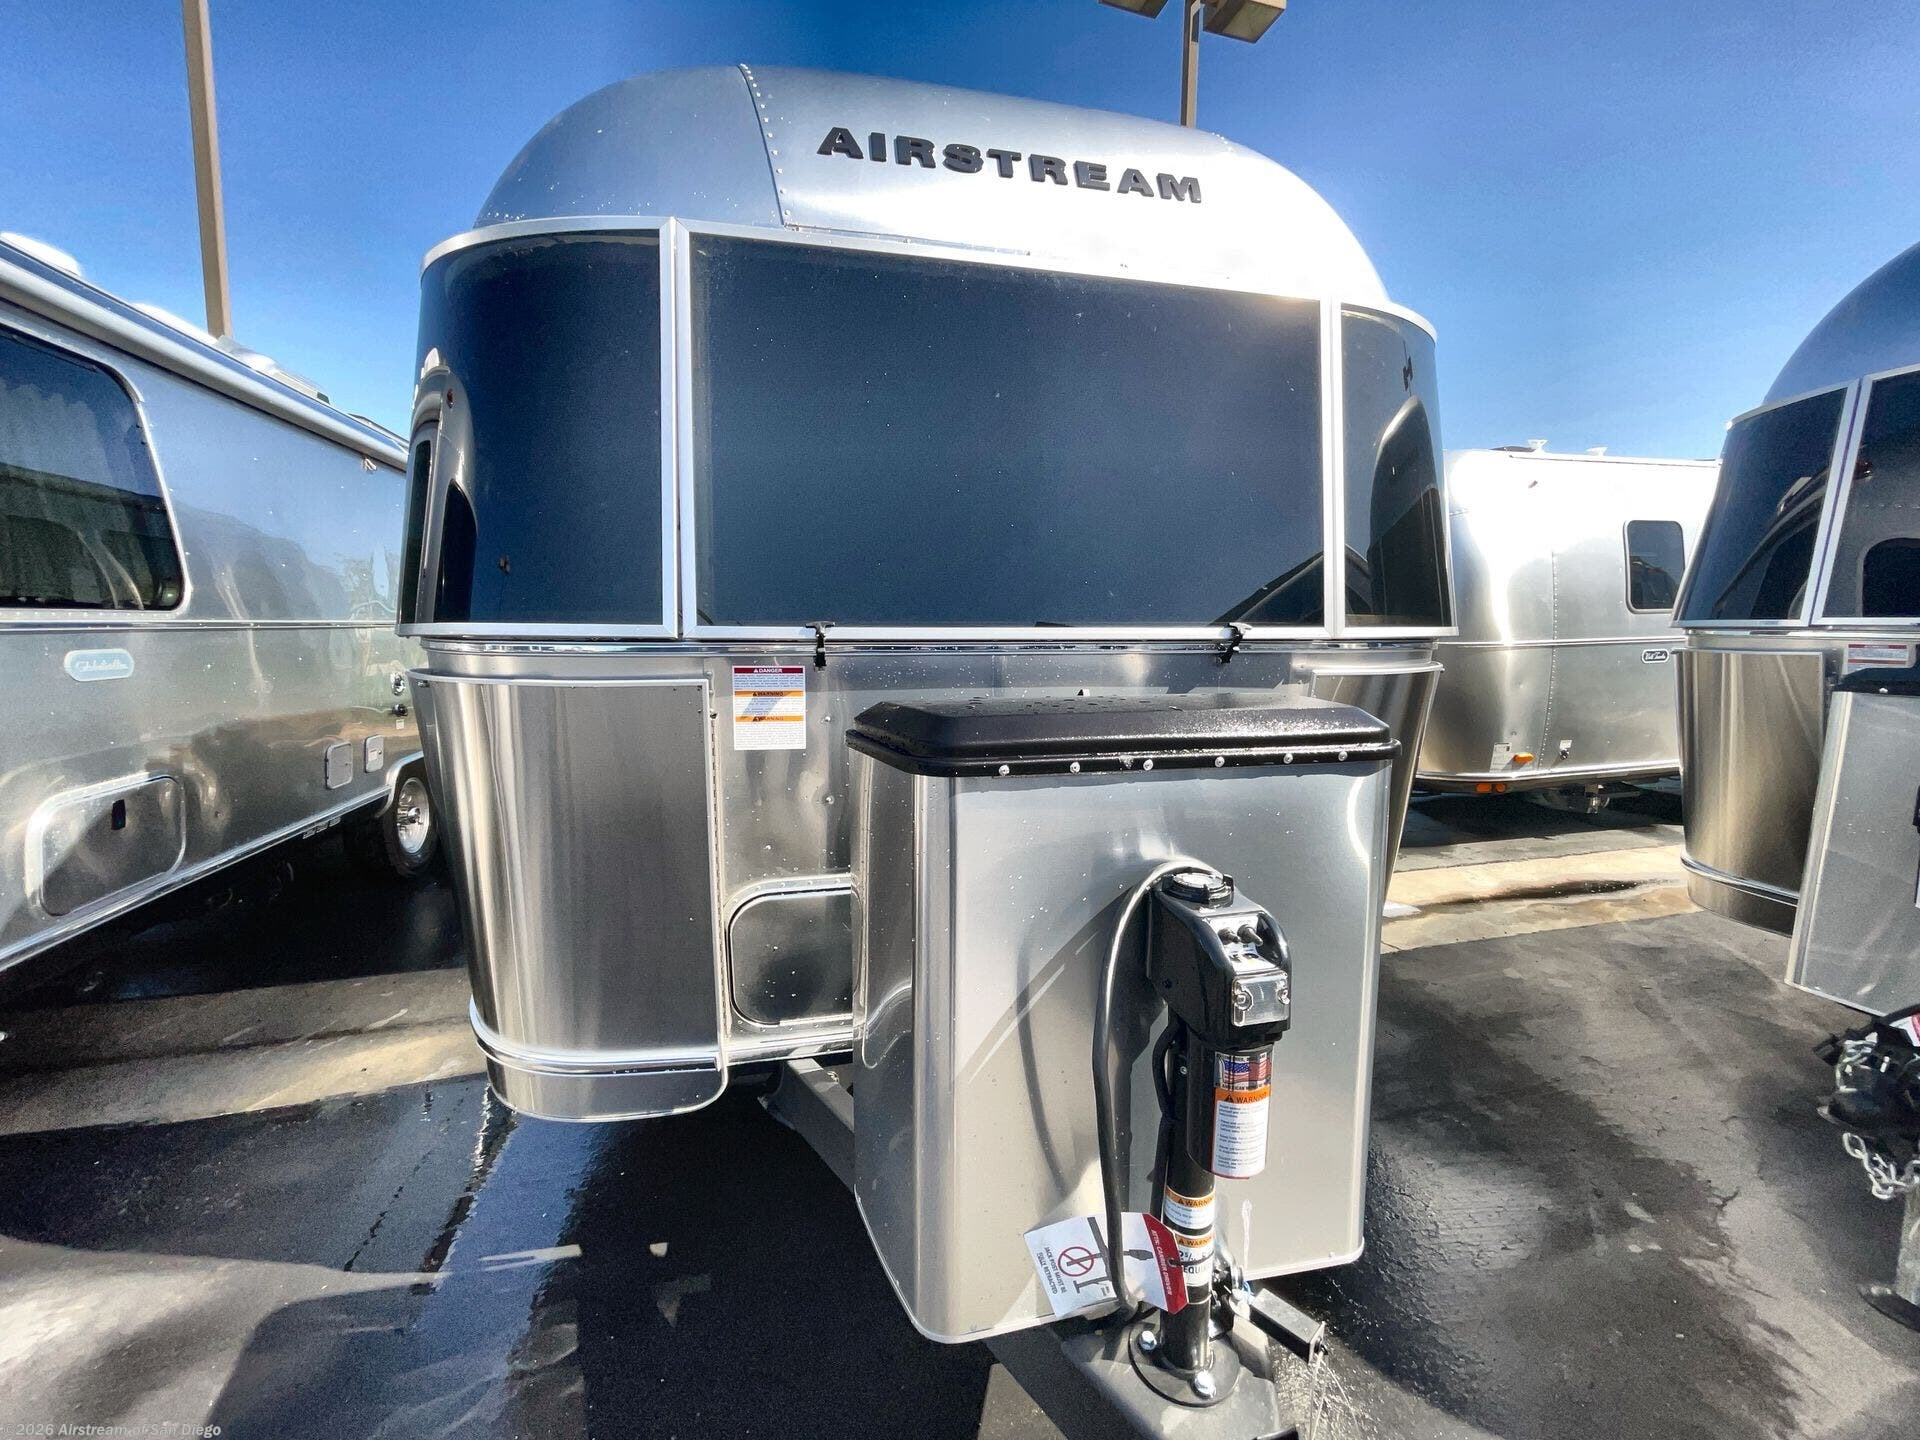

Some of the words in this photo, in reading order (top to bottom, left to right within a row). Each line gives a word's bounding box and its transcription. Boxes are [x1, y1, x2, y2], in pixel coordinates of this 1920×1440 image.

[816, 126, 1201, 204] AIRSTREAM
[1185, 1197, 1212, 1206] WARN
[1042, 1266, 1058, 1295] RETRACTED
[1157, 1246, 1169, 1272] CARRIER
[1163, 1271, 1173, 1296] DRIVER
